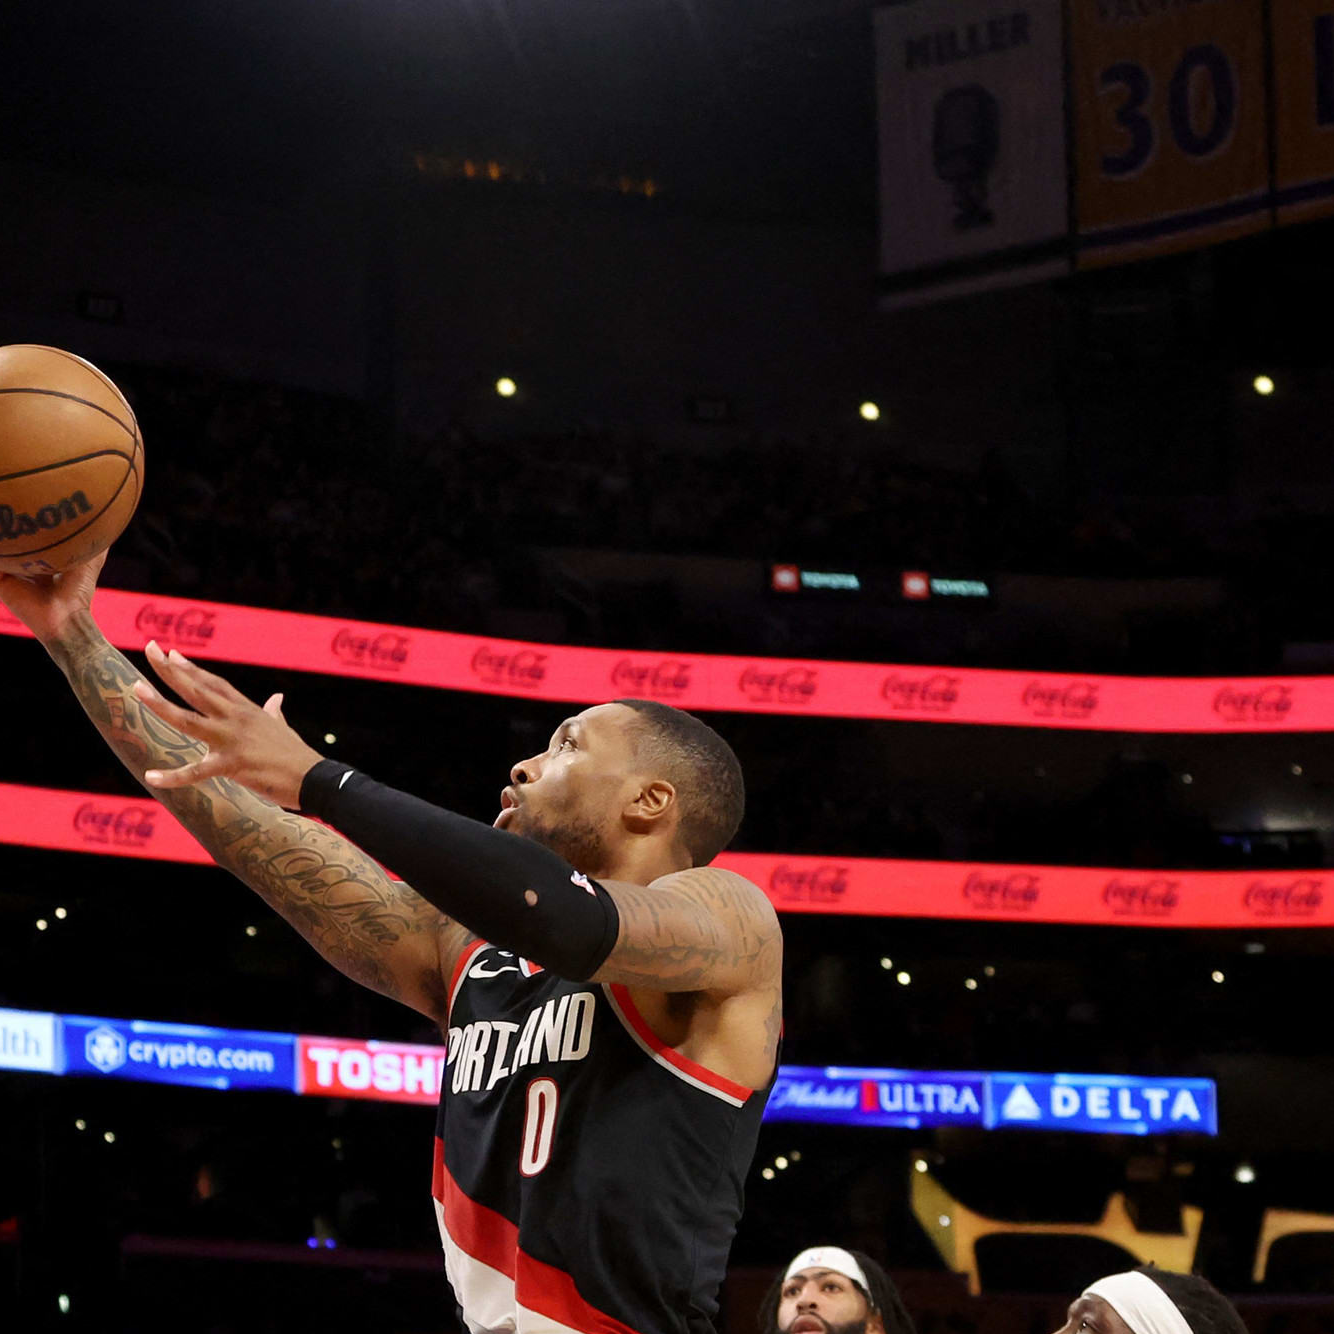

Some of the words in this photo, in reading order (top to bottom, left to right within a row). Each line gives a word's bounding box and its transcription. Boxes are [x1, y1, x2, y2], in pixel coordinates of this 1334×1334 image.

[904, 13, 1033, 72] MILLER
[1099, 44, 1238, 178] 30
[128, 1039, 274, 1074] crypto.com
[880, 1083, 981, 1114] ULTRA
[1050, 1083, 1201, 1122] DELTA
[519, 1076, 561, 1178] 0
